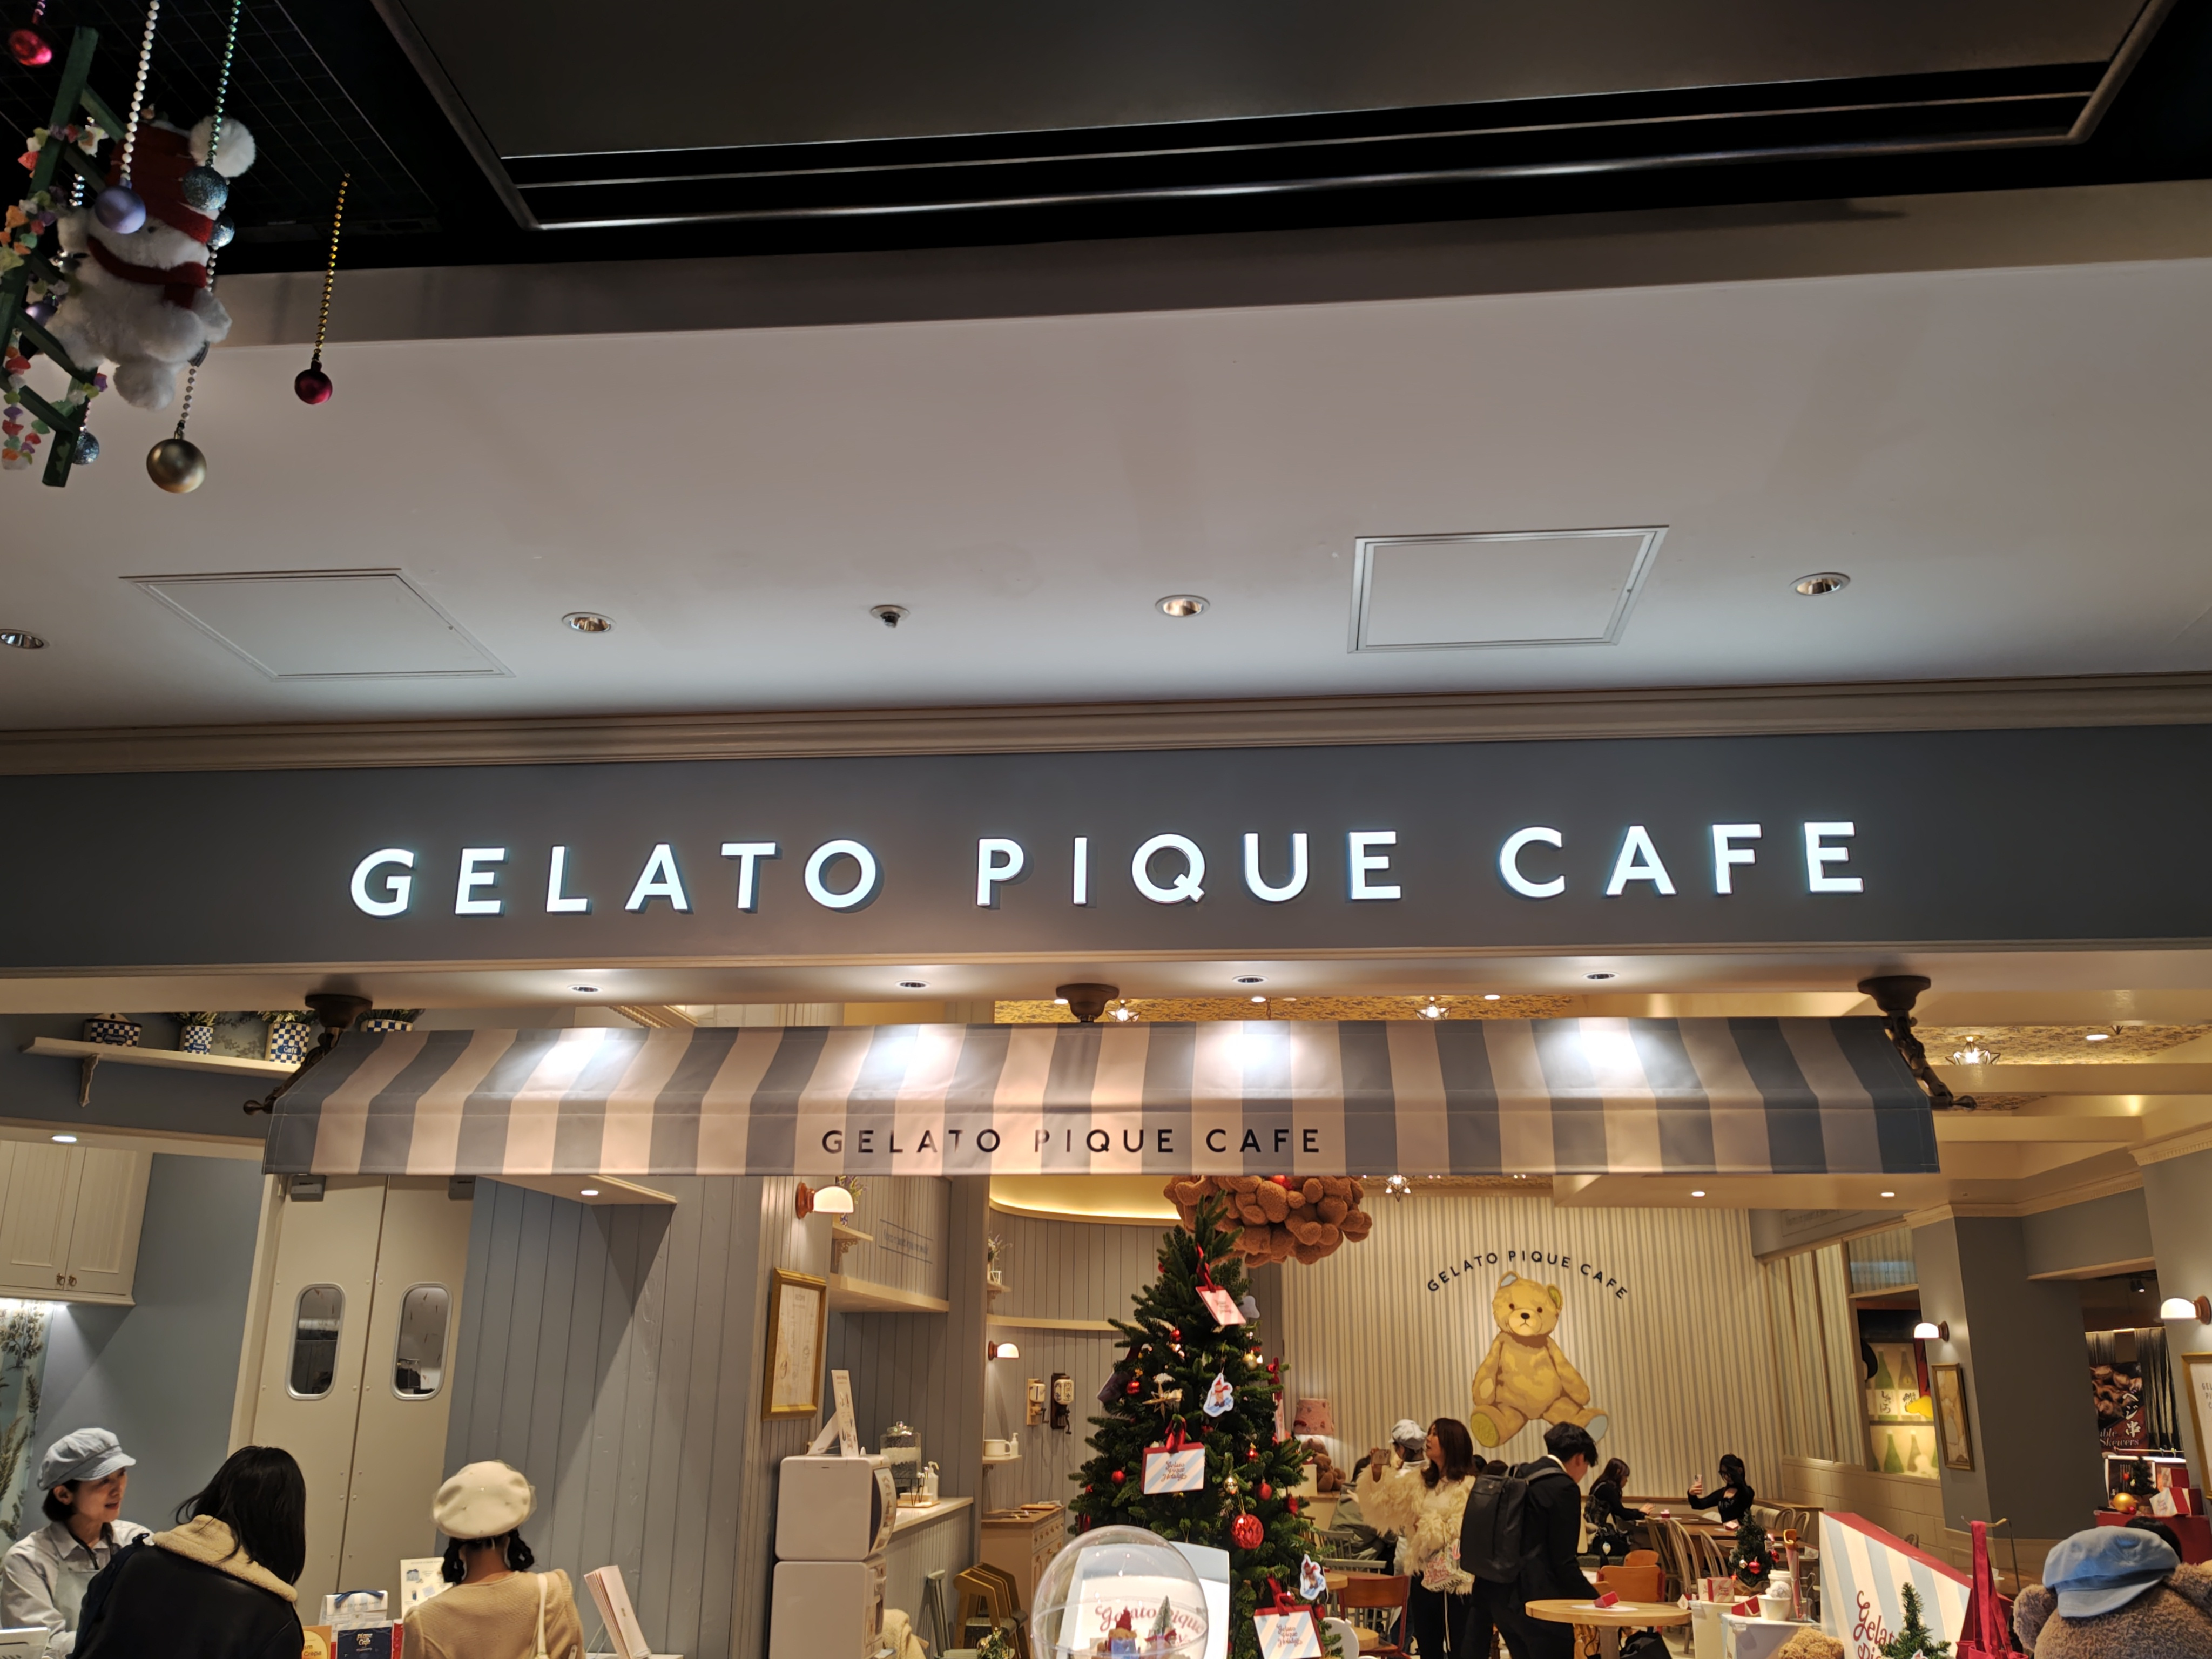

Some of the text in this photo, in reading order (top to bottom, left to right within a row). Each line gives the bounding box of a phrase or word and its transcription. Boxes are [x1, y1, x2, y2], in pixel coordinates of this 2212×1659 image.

[350, 821, 1864, 917] GELATO PIQUE CAFE
[822, 1128, 1319, 1154] GELATO PIQUE CAFE
[1427, 1250, 1628, 1299] GELATO PIQUE CAFE
